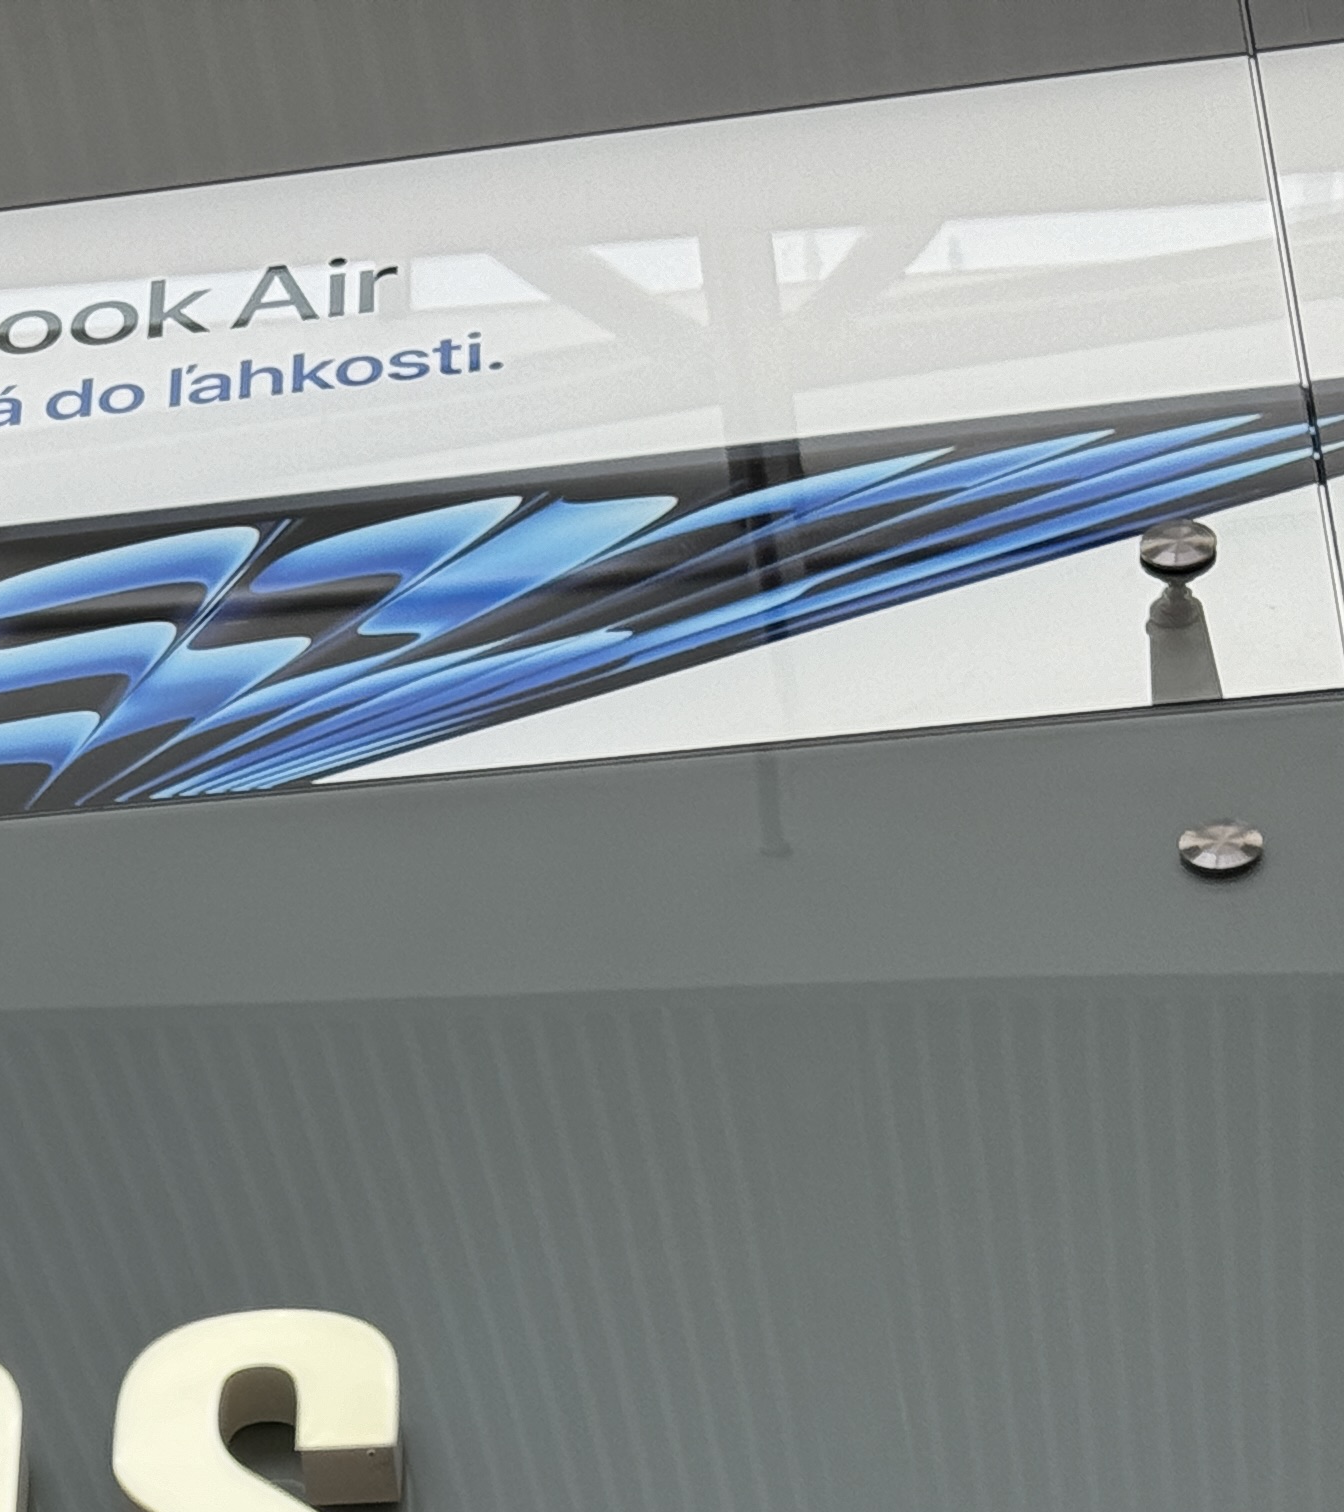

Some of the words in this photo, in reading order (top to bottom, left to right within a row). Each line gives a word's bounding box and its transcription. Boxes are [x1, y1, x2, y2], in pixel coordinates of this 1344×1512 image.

[230, 256, 399, 330] Air
[45, 377, 145, 420] do
[168, 330, 505, 407] ľahkosti.
